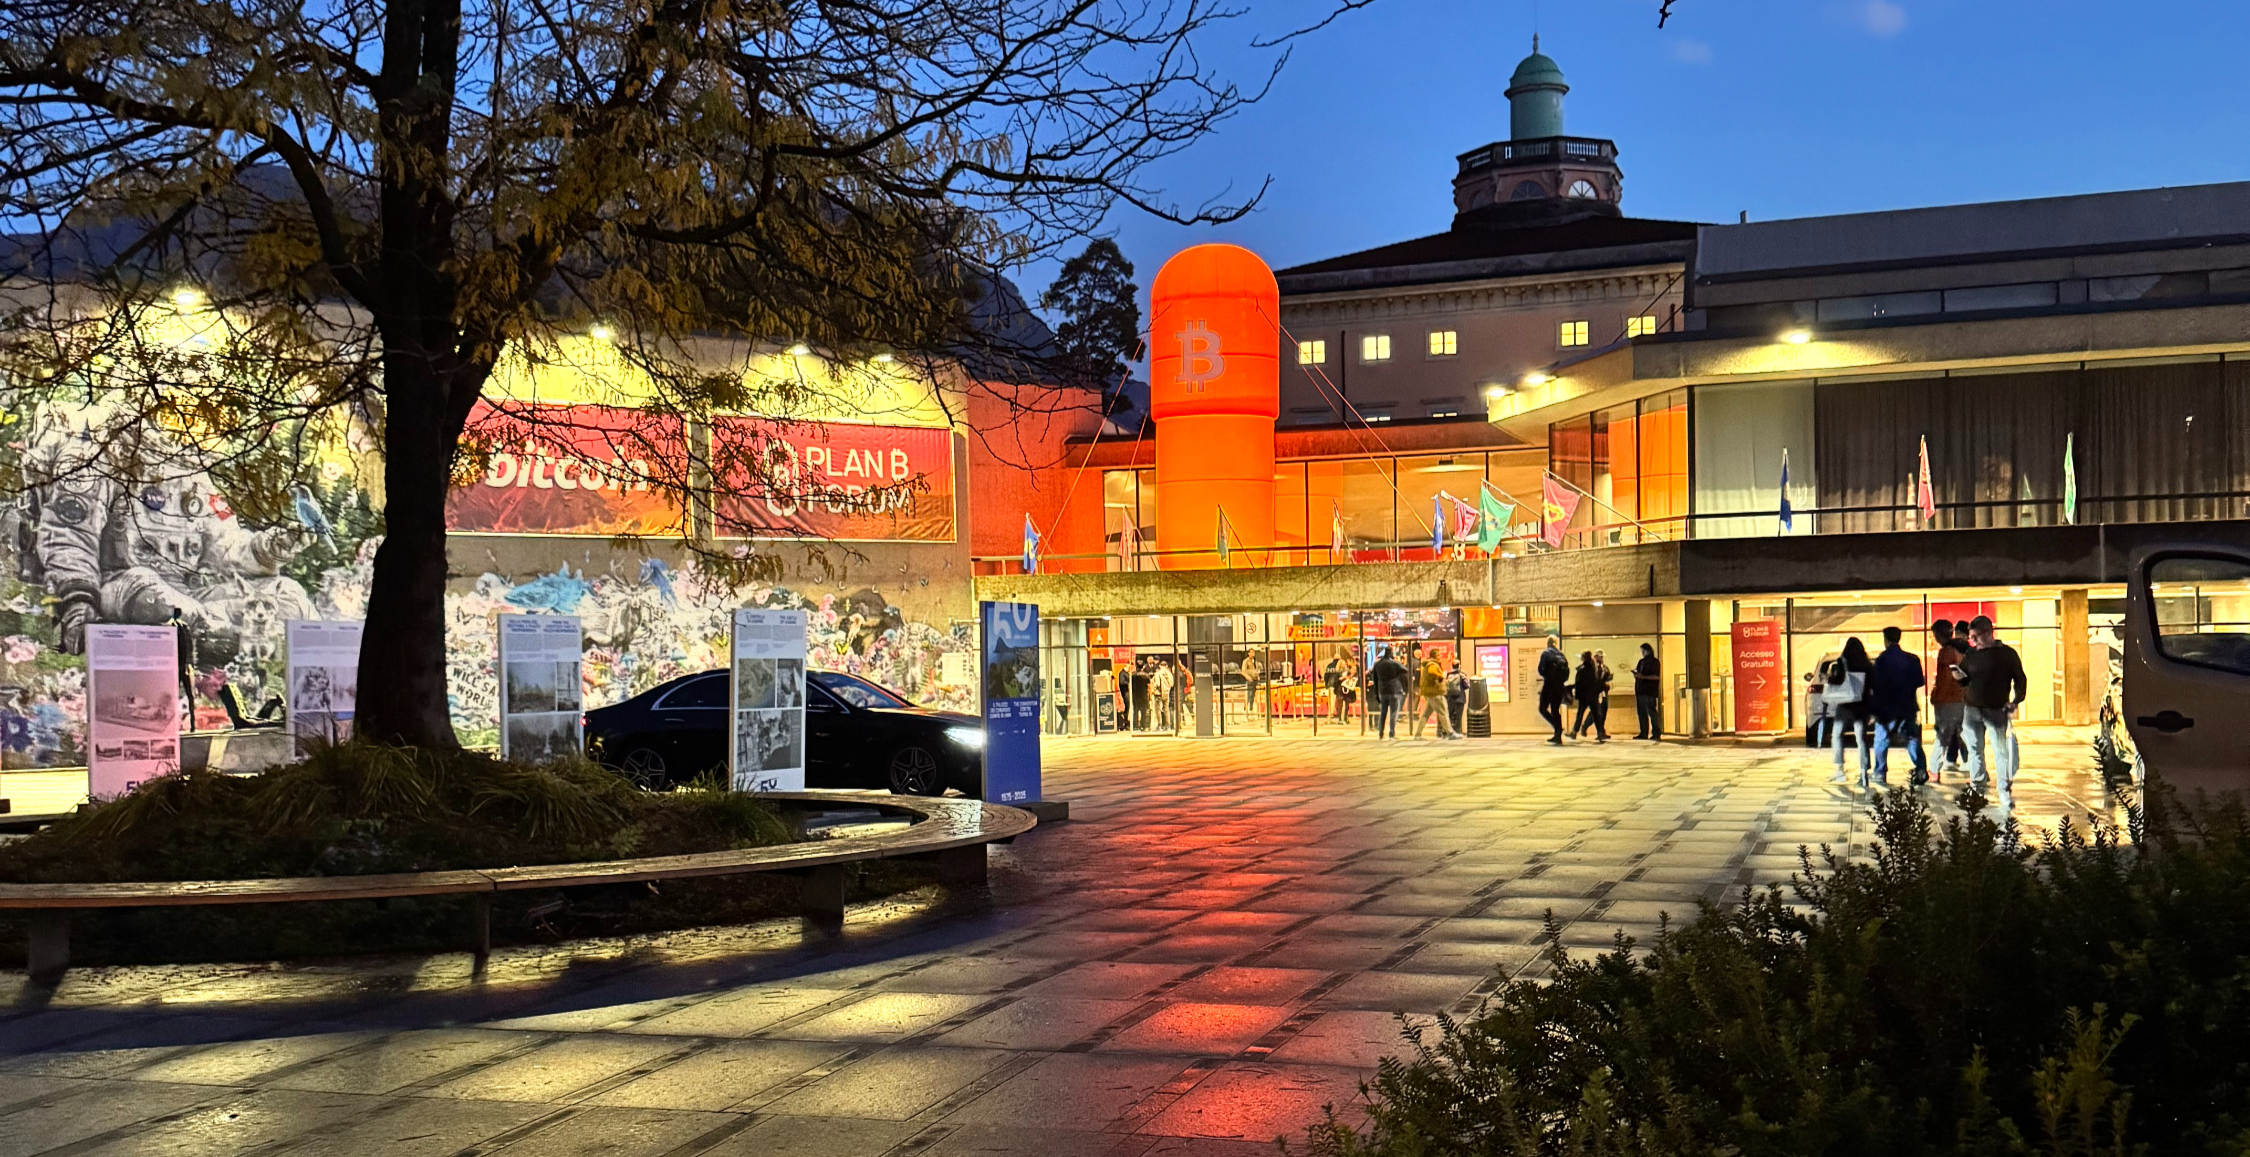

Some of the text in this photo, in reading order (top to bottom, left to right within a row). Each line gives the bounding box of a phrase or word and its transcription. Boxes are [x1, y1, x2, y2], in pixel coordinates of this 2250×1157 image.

[485, 440, 650, 492] bitcoin
[805, 446, 884, 478] PLAN
[807, 483, 910, 515] FORUM
[1741, 660, 1774, 668] Gratuito
[453, 668, 499, 697] WILL SA
